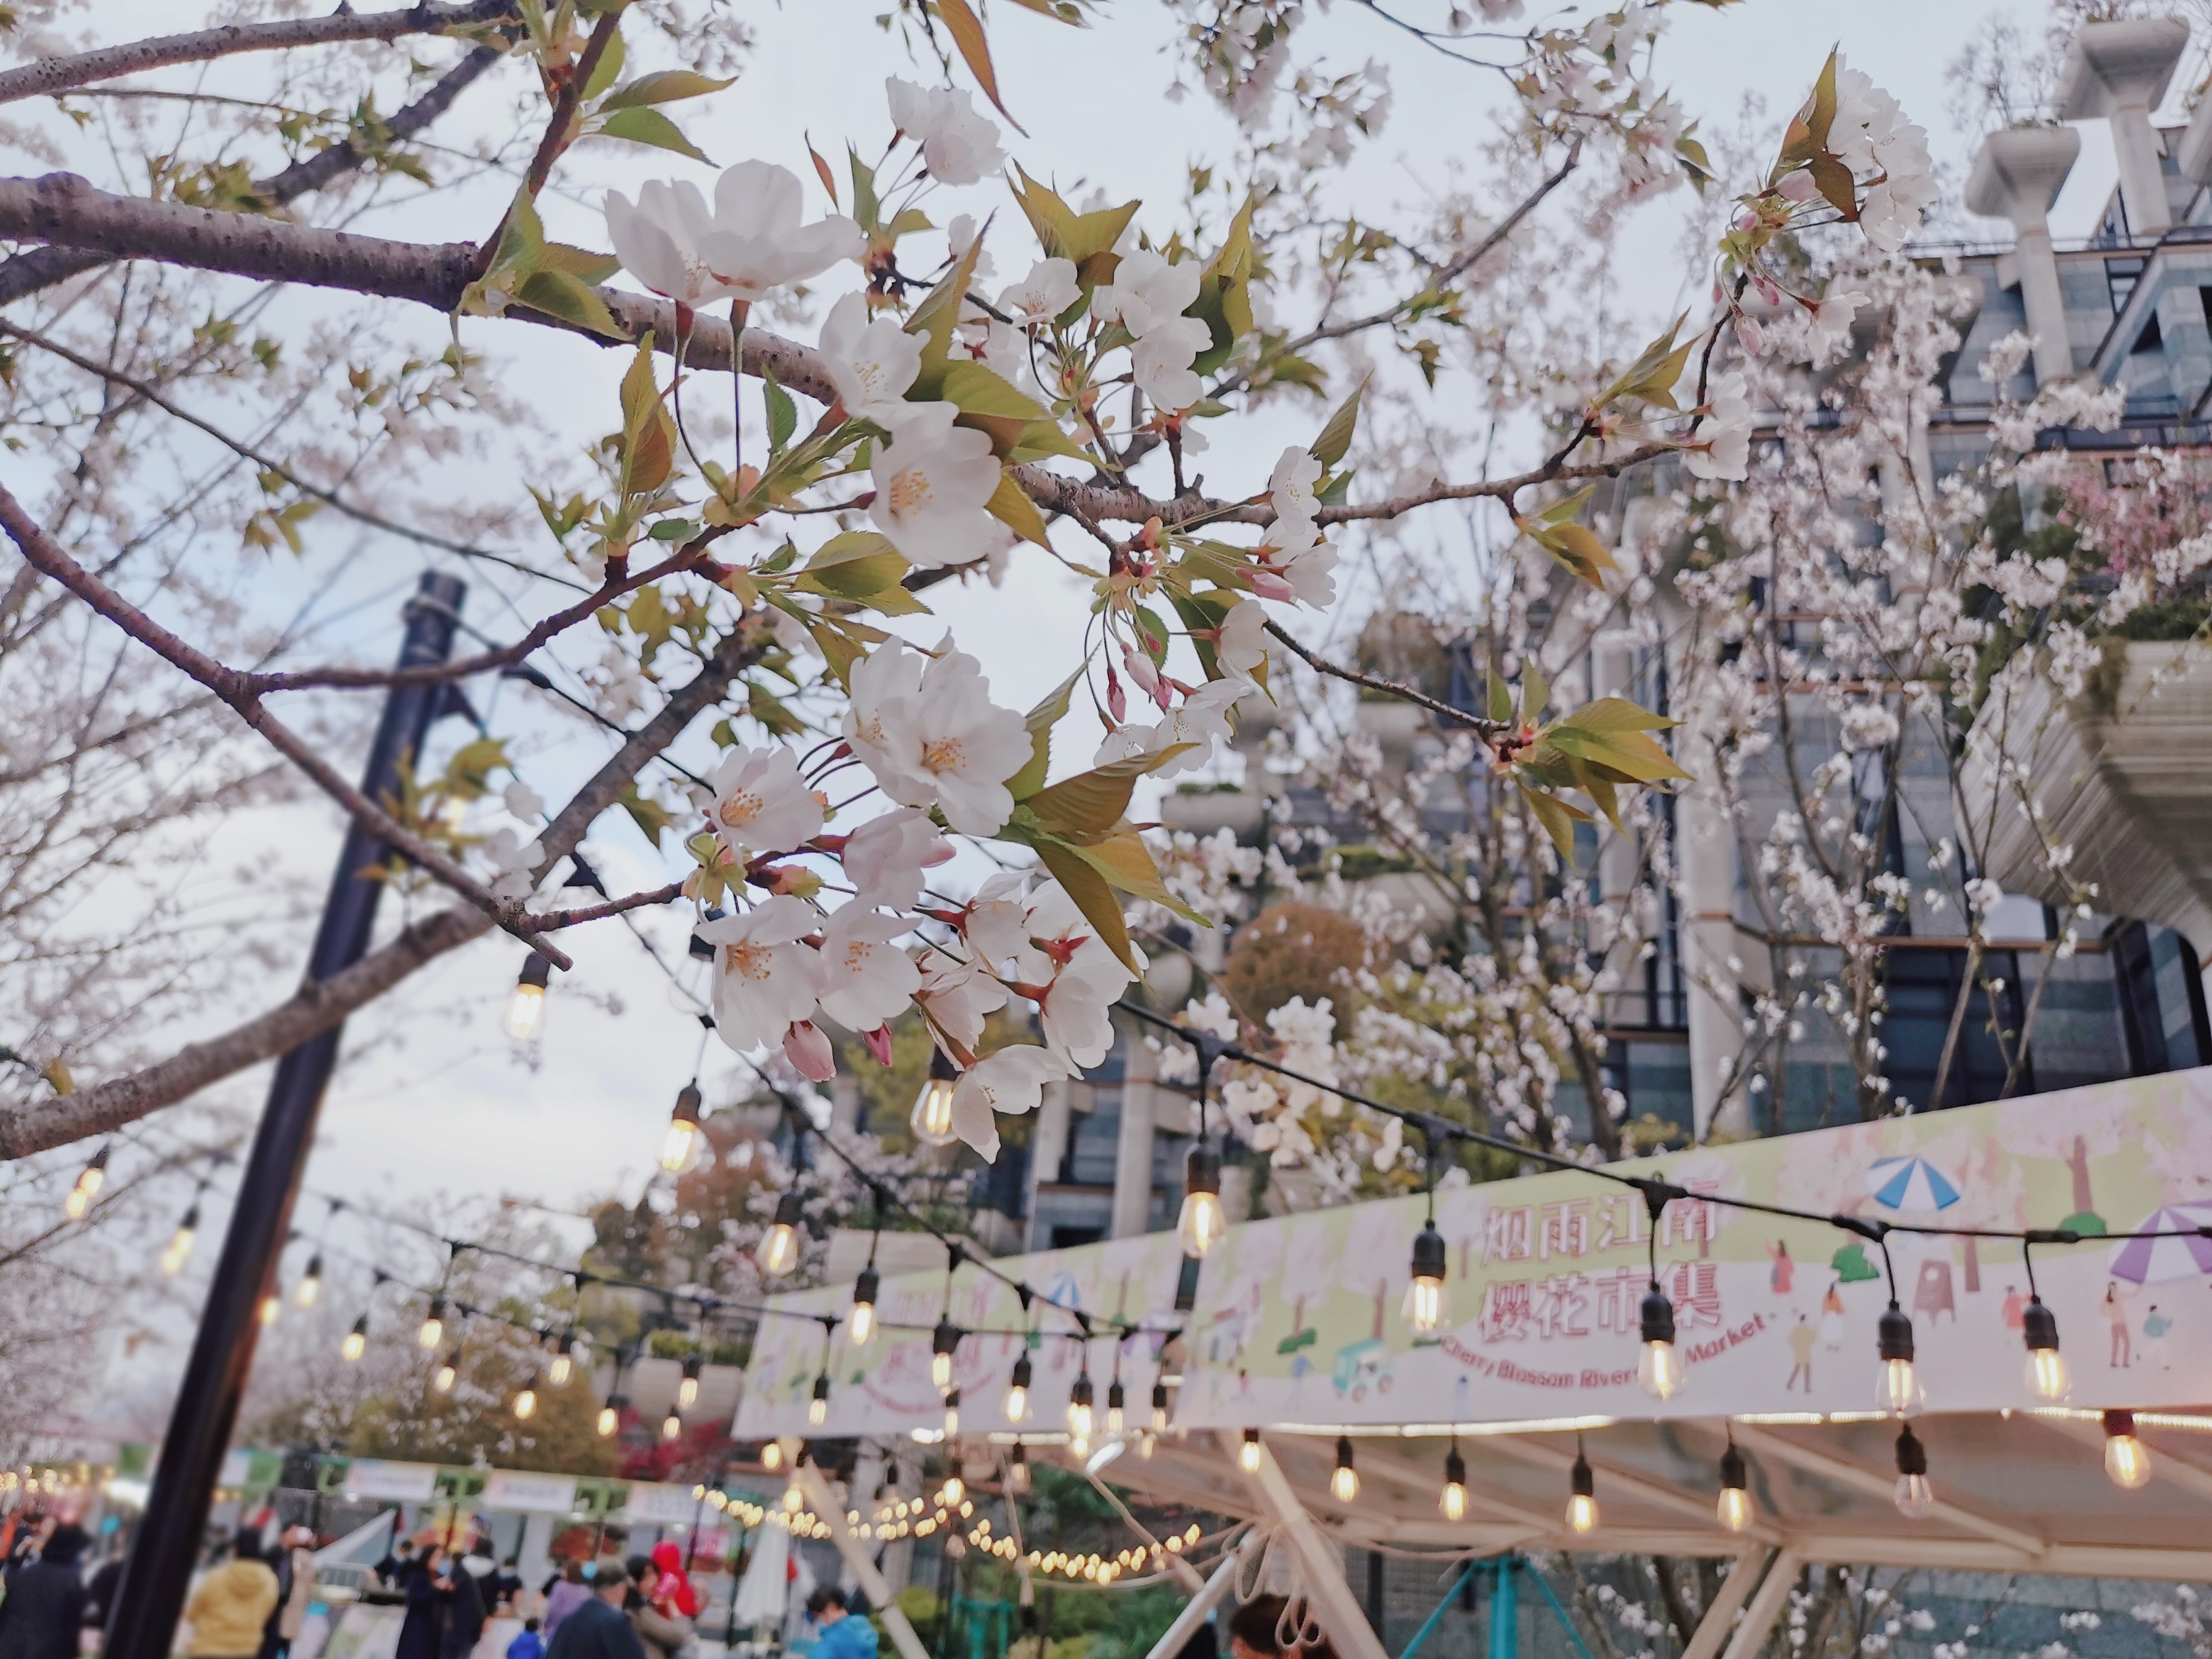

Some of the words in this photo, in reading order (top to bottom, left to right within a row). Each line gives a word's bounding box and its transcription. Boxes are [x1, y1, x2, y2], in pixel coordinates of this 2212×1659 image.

[1482, 1178, 1717, 1267] 烟雨江南
[1479, 1259, 1720, 1342] 樱花市集
[1685, 1312, 1765, 1366] Market
